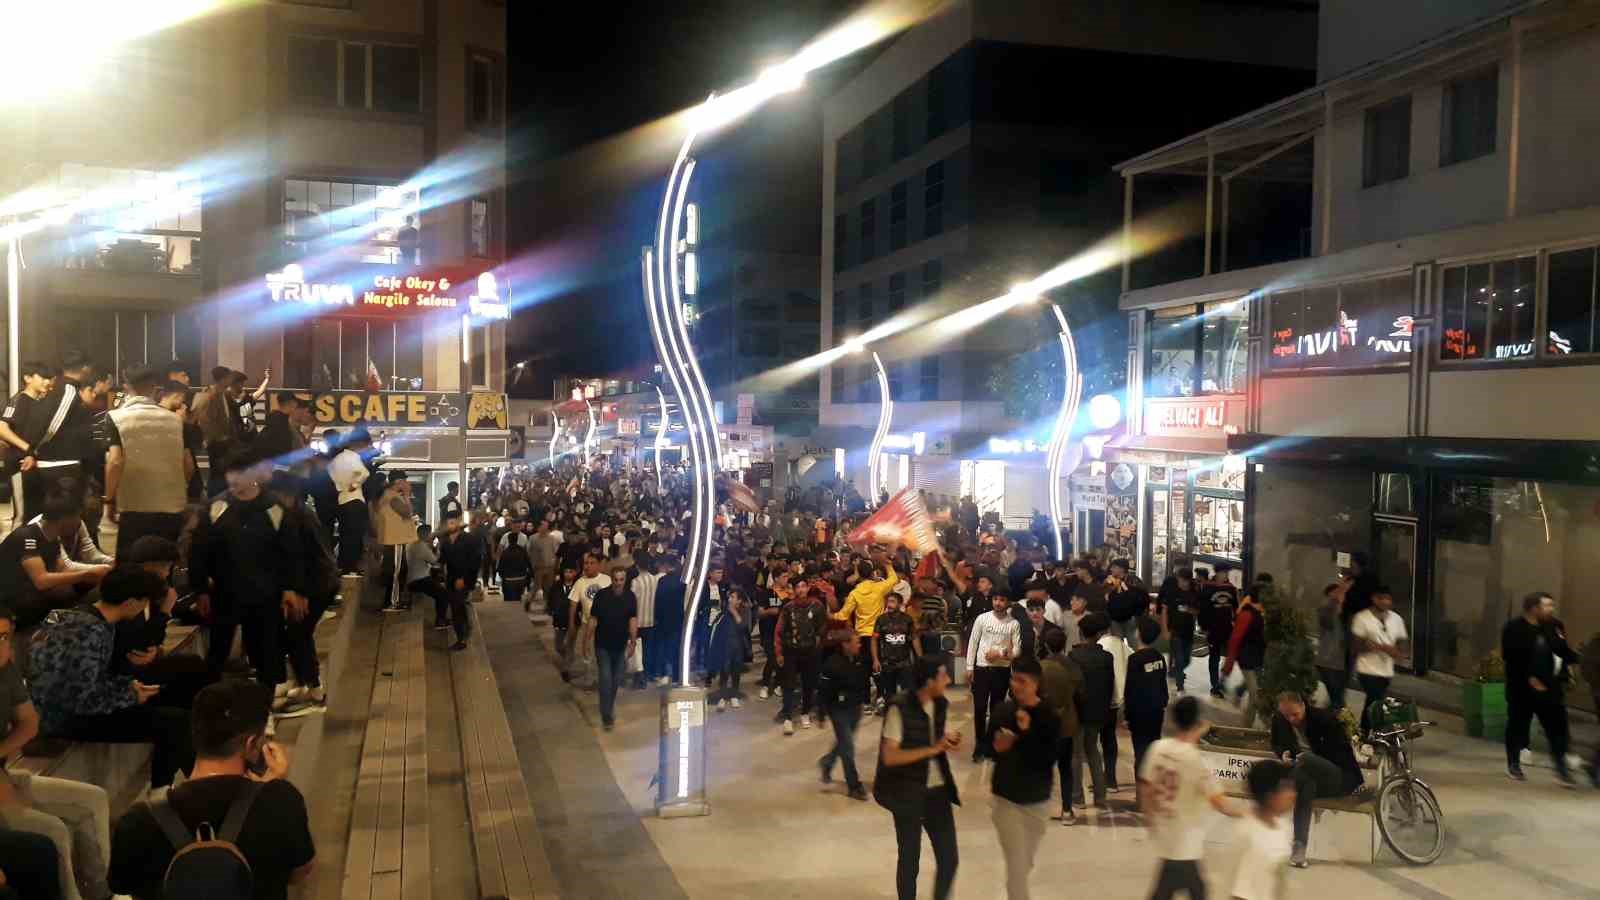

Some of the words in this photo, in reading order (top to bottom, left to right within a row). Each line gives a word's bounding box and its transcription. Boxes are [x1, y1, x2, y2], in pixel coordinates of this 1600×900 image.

[374, 276, 402, 291] Cafe
[406, 276, 435, 291] Okey
[438, 278, 450, 290] &
[364, 292, 410, 307] Nargile
